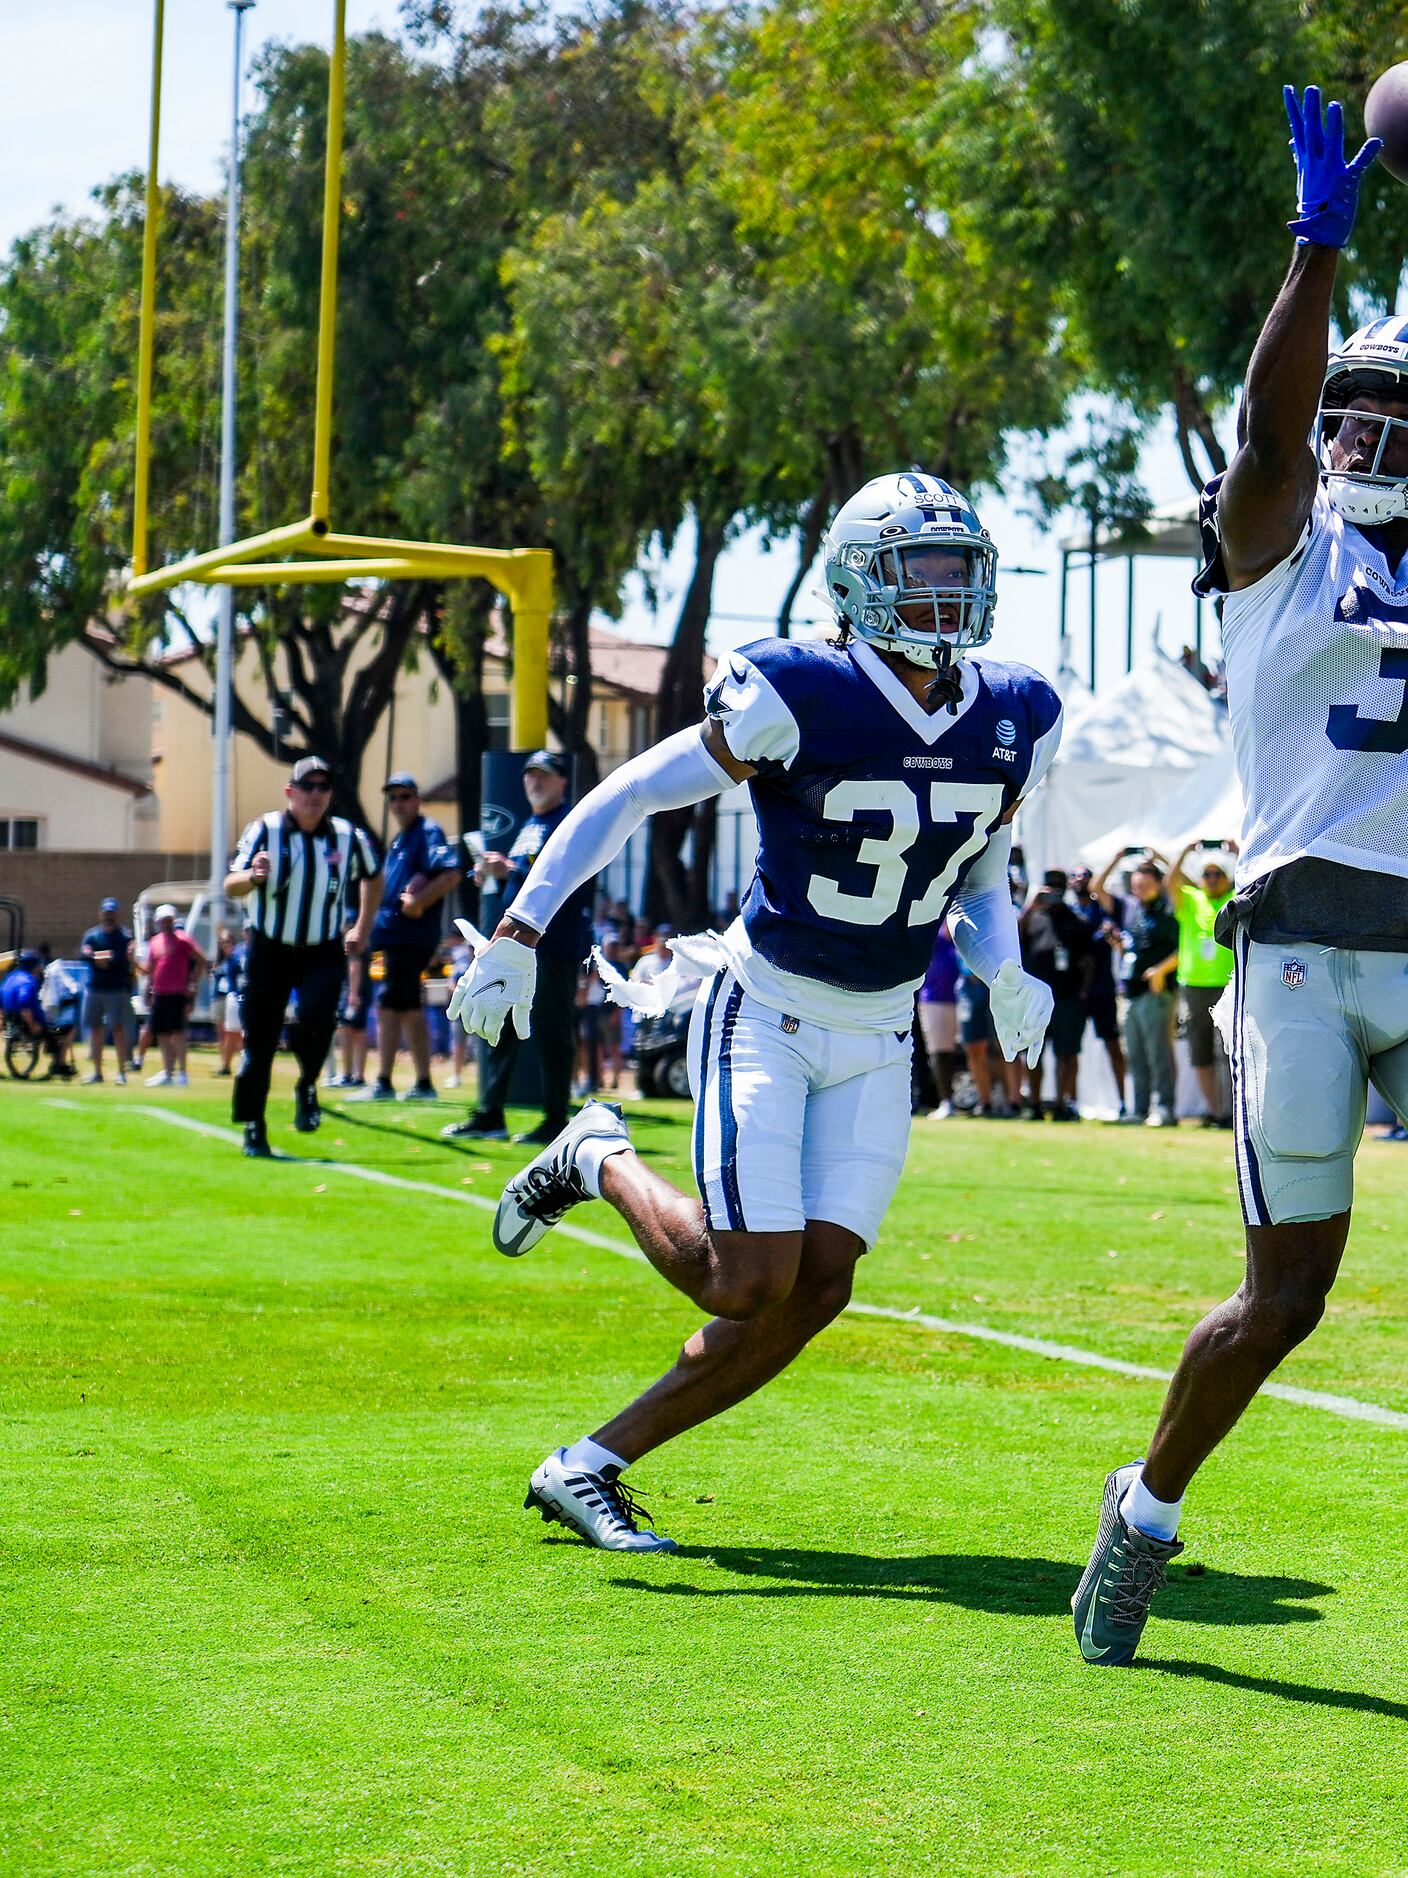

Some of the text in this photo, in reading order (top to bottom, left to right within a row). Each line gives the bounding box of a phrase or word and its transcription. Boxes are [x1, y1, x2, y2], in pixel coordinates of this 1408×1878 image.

[1360, 344, 1399, 353] COWBOYS
[914, 493, 958, 504] SCOTT
[992, 747, 1018, 762] AT&T
[903, 756, 953, 769] COWBOYS
[807, 780, 1005, 927] 37
[1284, 971, 1304, 984] NFL
